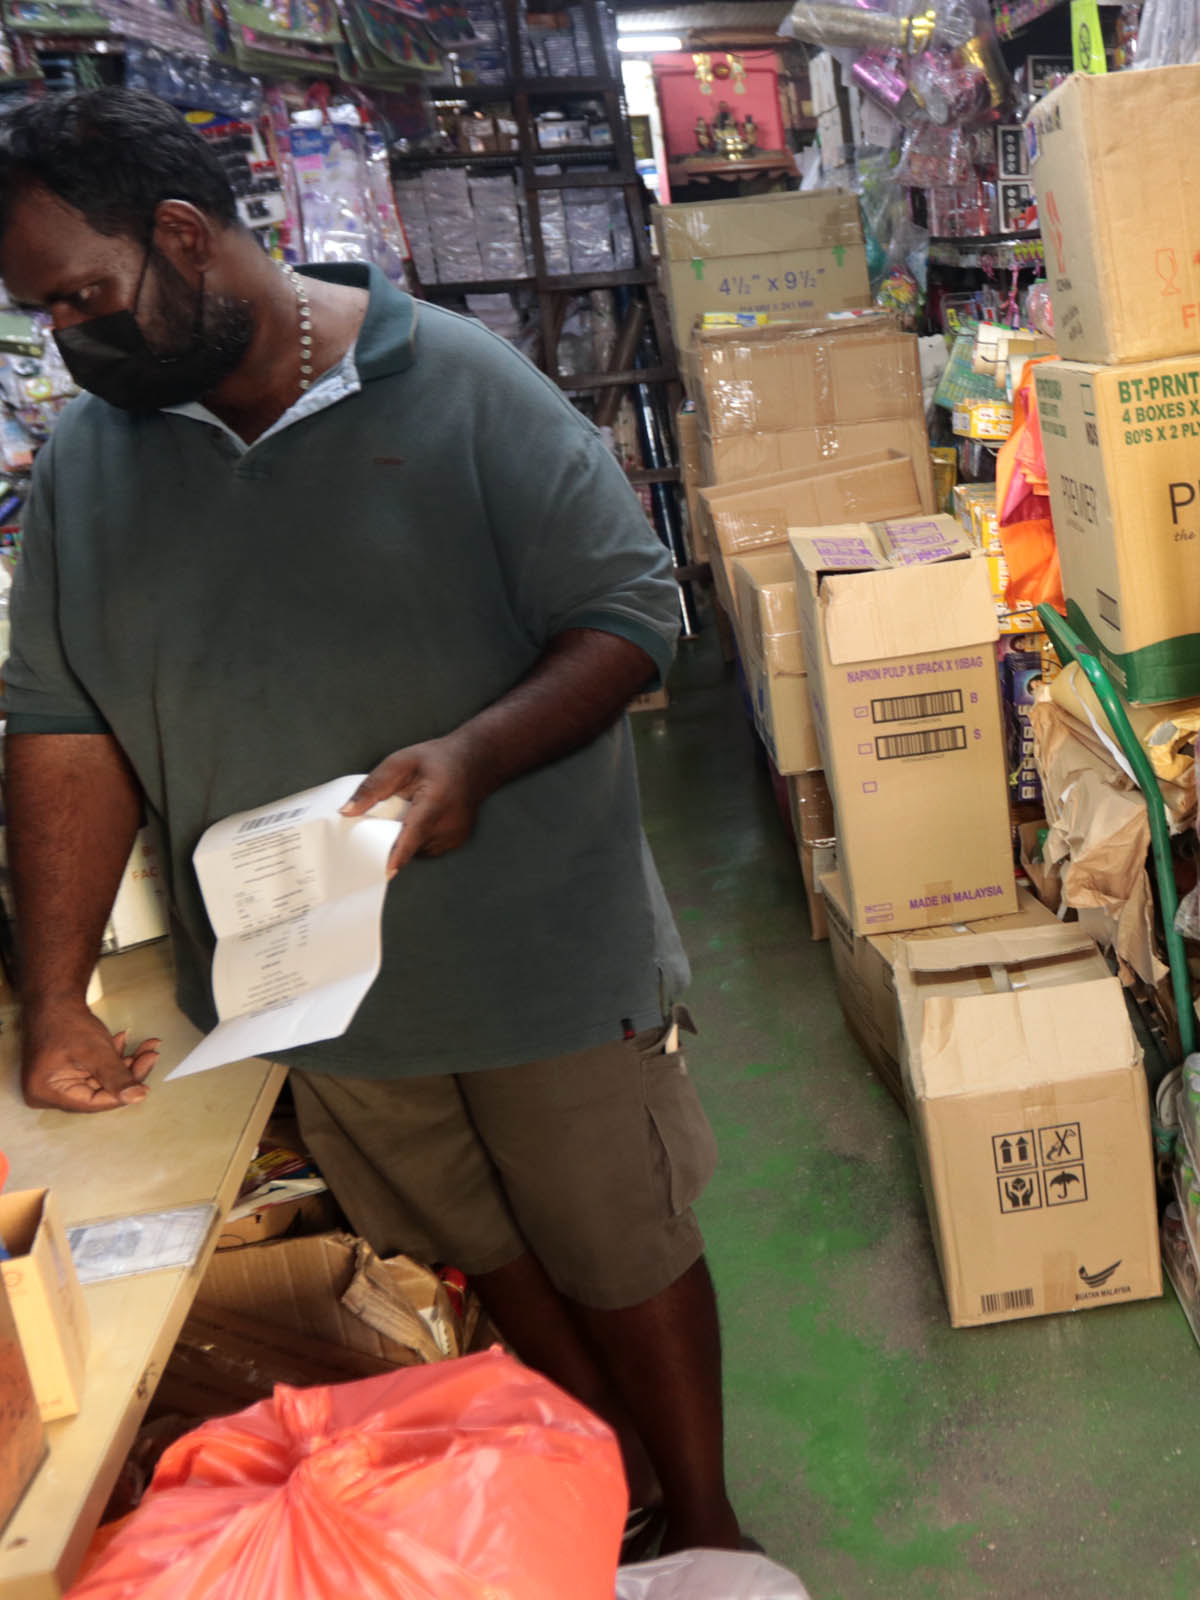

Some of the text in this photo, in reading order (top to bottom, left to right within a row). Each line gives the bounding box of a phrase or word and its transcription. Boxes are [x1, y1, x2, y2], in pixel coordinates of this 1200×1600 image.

[1122, 408, 1132, 424] 4
[1136, 402, 1186, 423] BOXES
[1189, 399, 1200, 416] X
[1157, 426, 1167, 441] X
[1170, 425, 1179, 439] 2
[883, 665, 906, 678] PULP
[909, 885, 1004, 910] MADE IN MALAYSIA
